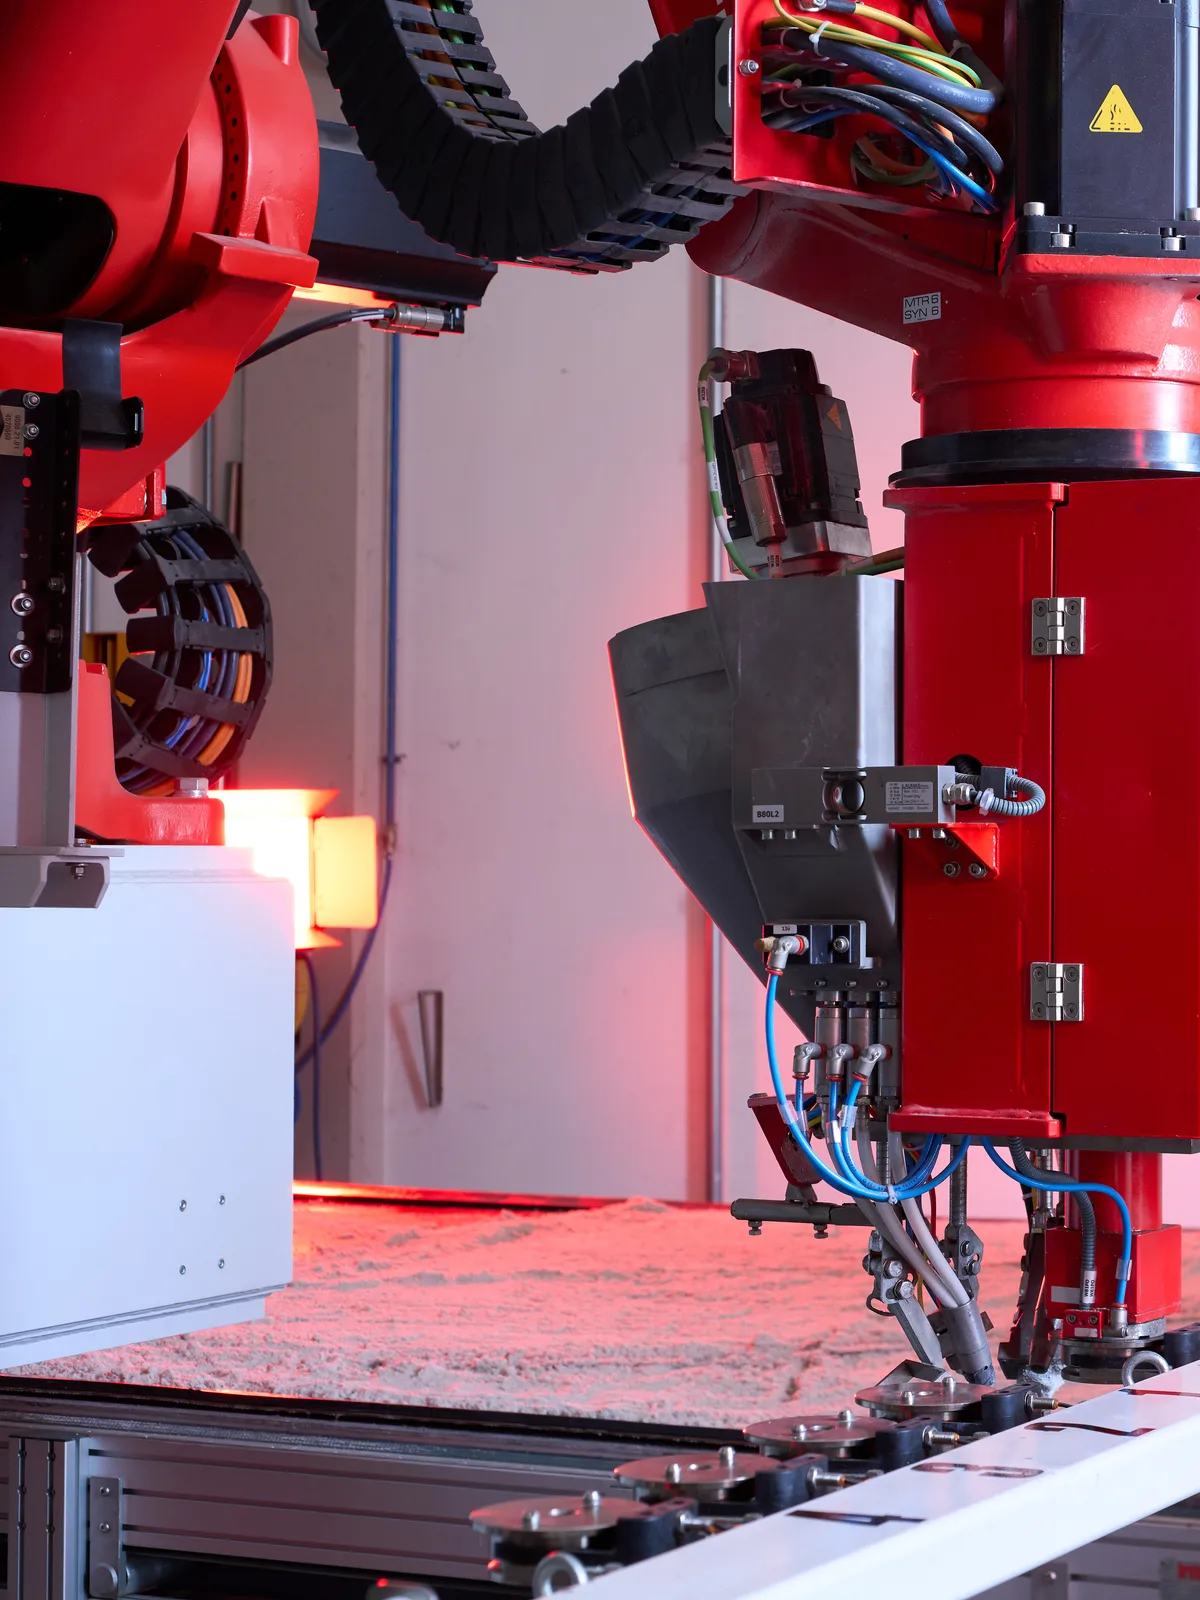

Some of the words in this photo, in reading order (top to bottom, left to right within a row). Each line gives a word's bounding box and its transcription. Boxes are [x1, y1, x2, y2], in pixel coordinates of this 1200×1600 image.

[904, 295, 930, 308] MTR
[904, 308, 928, 320] SYN
[931, 306, 939, 316] 6
